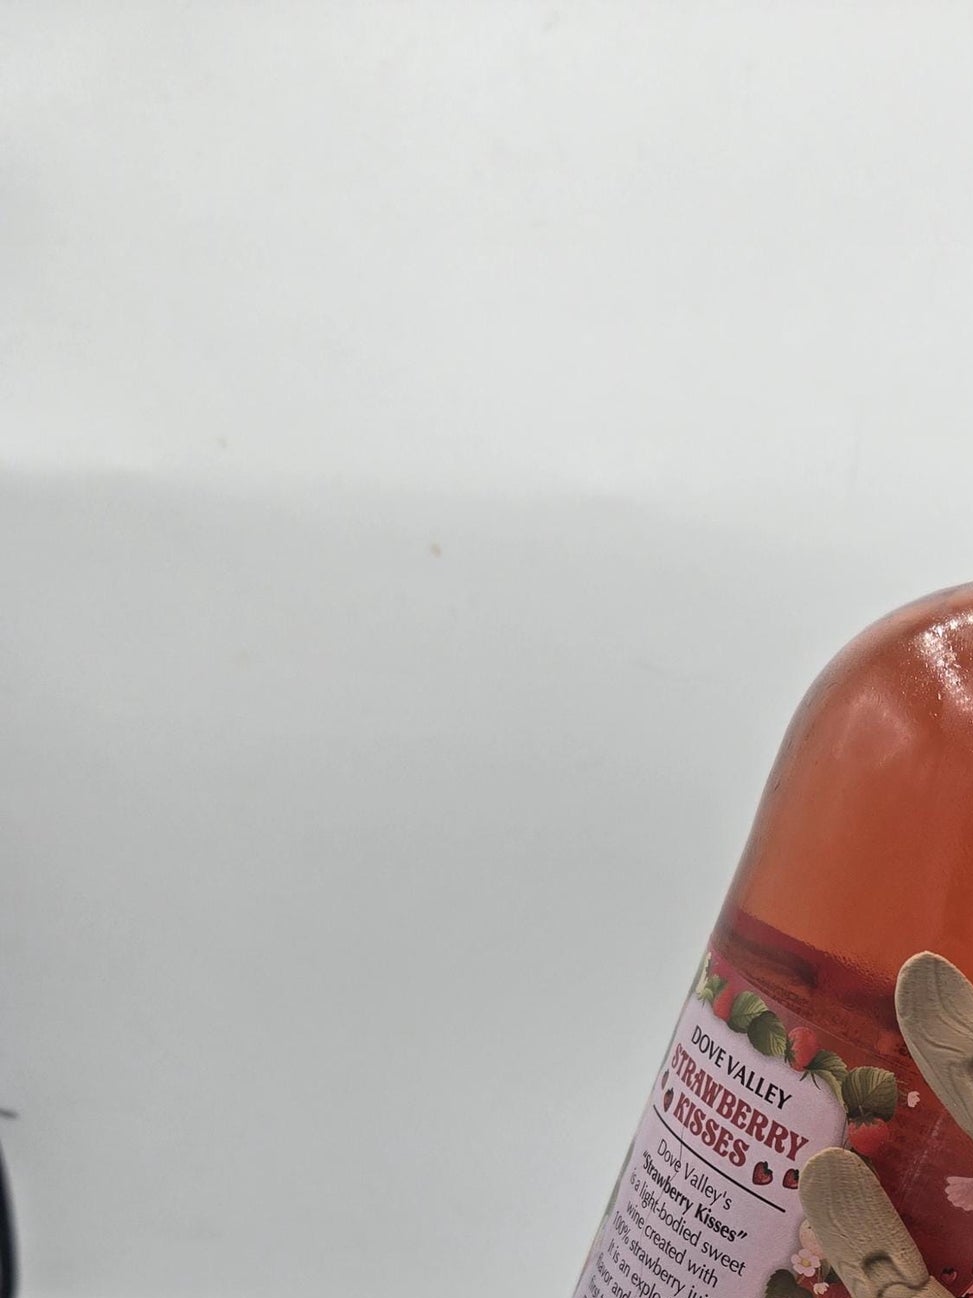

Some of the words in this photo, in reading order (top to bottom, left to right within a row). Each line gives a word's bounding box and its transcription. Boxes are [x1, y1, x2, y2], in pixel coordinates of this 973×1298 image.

[671, 1043, 810, 1162] STRAWBERRY
[691, 1025, 726, 1068] DOVE
[728, 1054, 793, 1110] VALLEY
[673, 1092, 750, 1167] KISSES
[657, 1138, 682, 1173] Dove
[684, 1163, 732, 1210] Valley's
[612, 1210, 630, 1244] 100%
[629, 1239, 686, 1296] strawberry
[612, 1242, 619, 1264] is
[618, 1258, 632, 1278] an
[626, 1200, 645, 1230] wine
[645, 1225, 687, 1265] created
[687, 1259, 718, 1288] with
[630, 1167, 636, 1184] is
[634, 1178, 641, 1191] a
[639, 1181, 702, 1247] light-bodied
[701, 1242, 746, 1277] sweet
